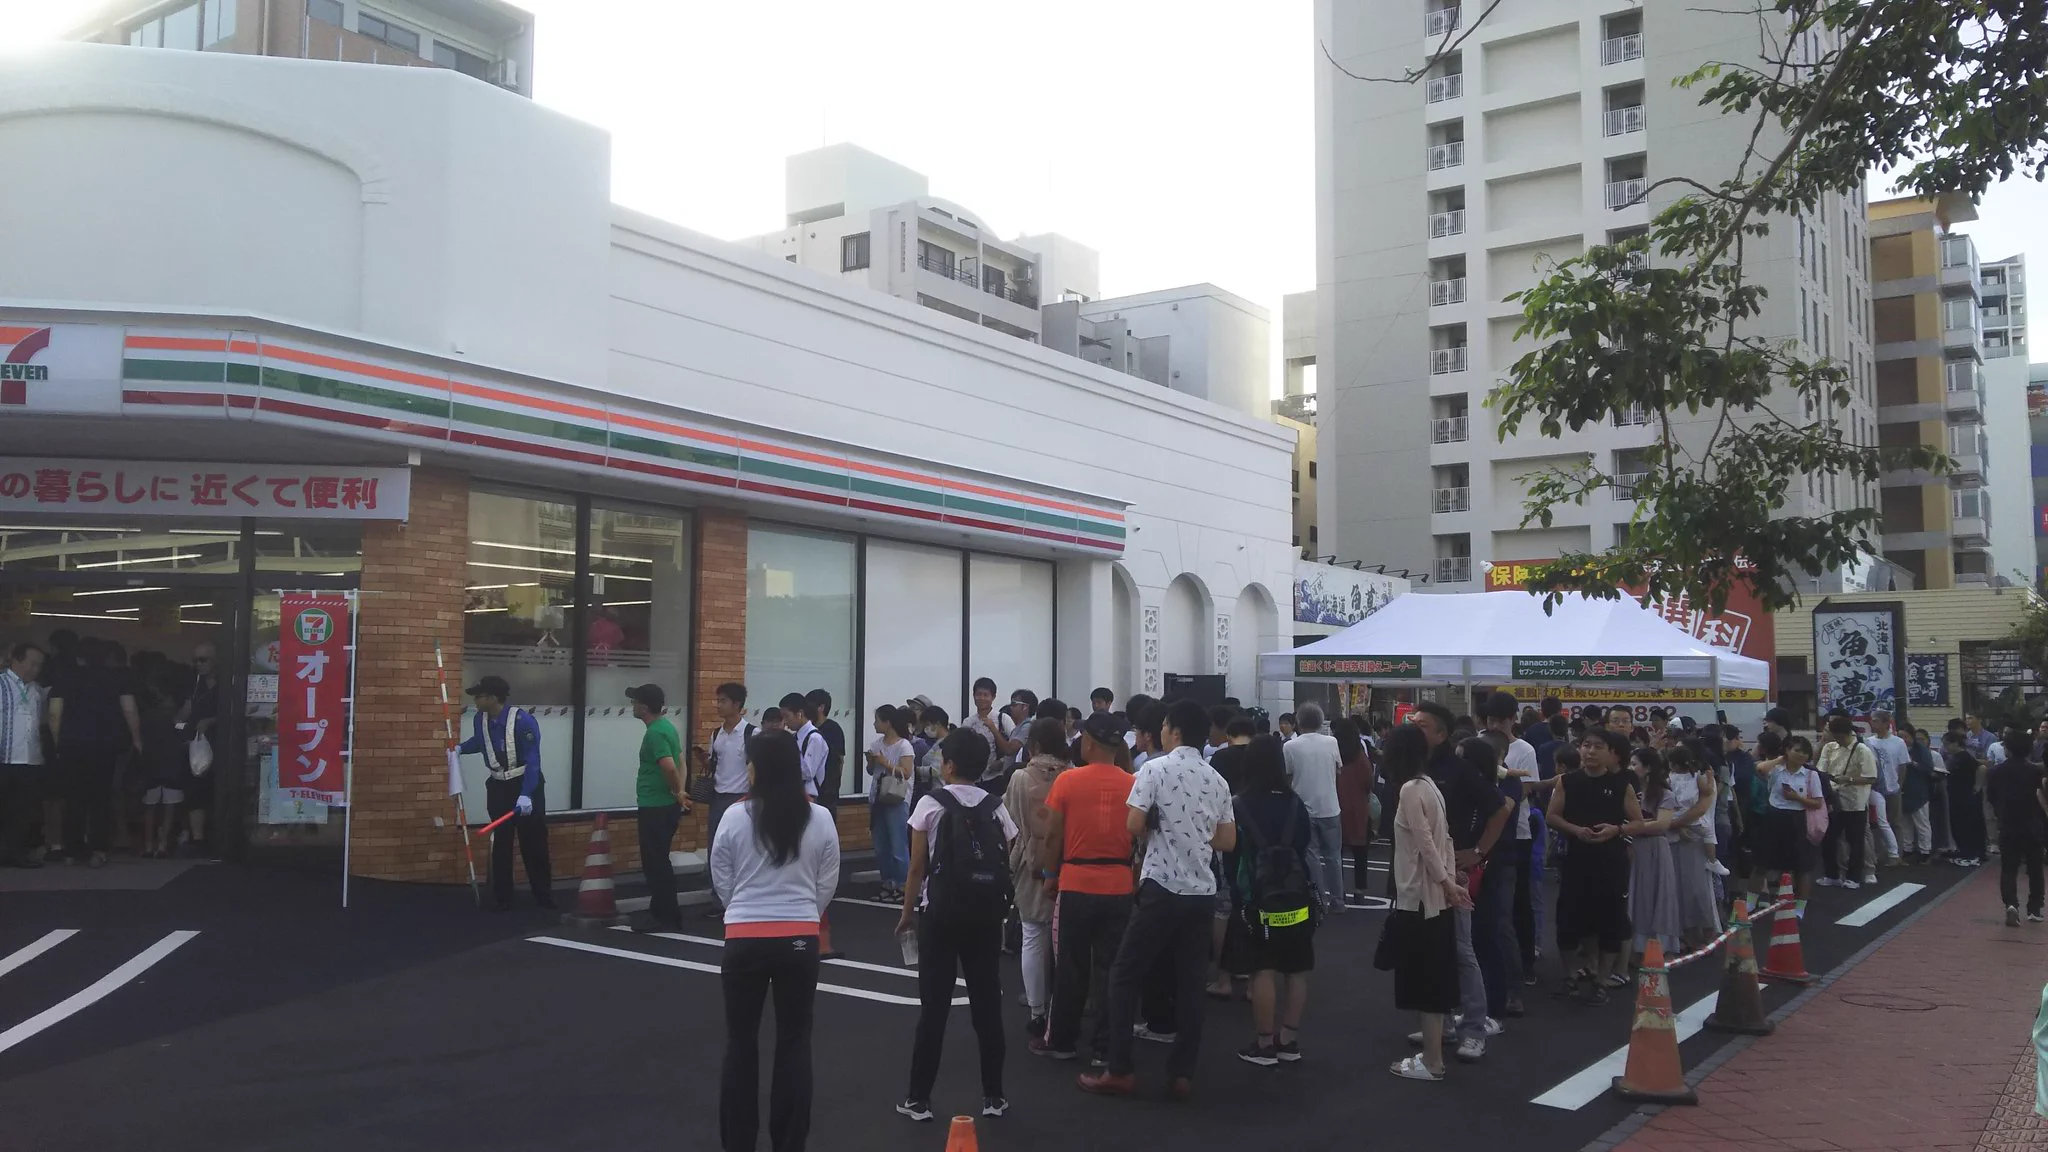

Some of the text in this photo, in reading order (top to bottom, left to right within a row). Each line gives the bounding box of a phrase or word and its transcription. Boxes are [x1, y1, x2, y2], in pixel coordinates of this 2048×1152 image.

[0, 469, 379, 510] の暮らしに 近くて便利
[1876, 620, 1890, 655] 北海道
[1579, 661, 1656, 677] 入会コーナー
[296, 650, 330, 783] オープン
